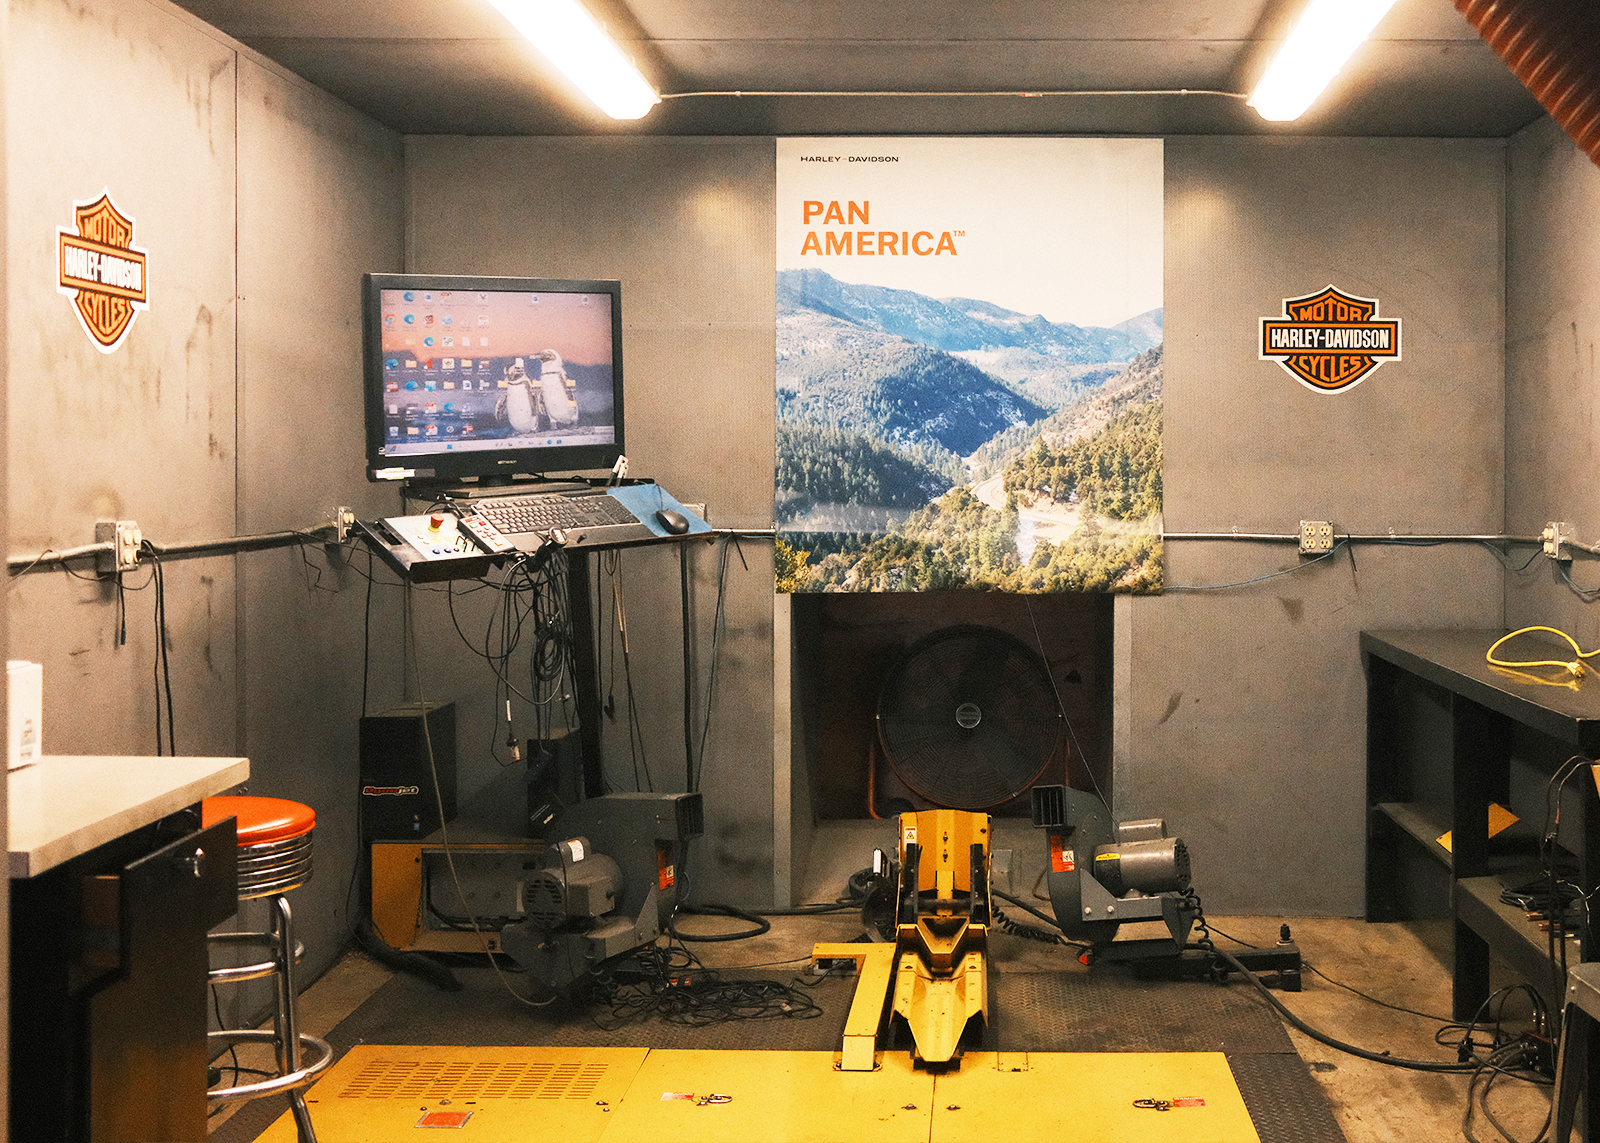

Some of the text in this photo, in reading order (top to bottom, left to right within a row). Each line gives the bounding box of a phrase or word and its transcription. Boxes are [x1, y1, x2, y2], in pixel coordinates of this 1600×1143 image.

[803, 200, 869, 225] PAN
[83, 207, 126, 249] MOTOR
[64, 244, 142, 291] HARLEY-DAVIDSON
[83, 290, 127, 335] CYCLES
[1300, 297, 1362, 322] MOTOR
[1271, 328, 1389, 349] HARLEY-DAVIDSON
[1299, 355, 1362, 382] CYCLES
